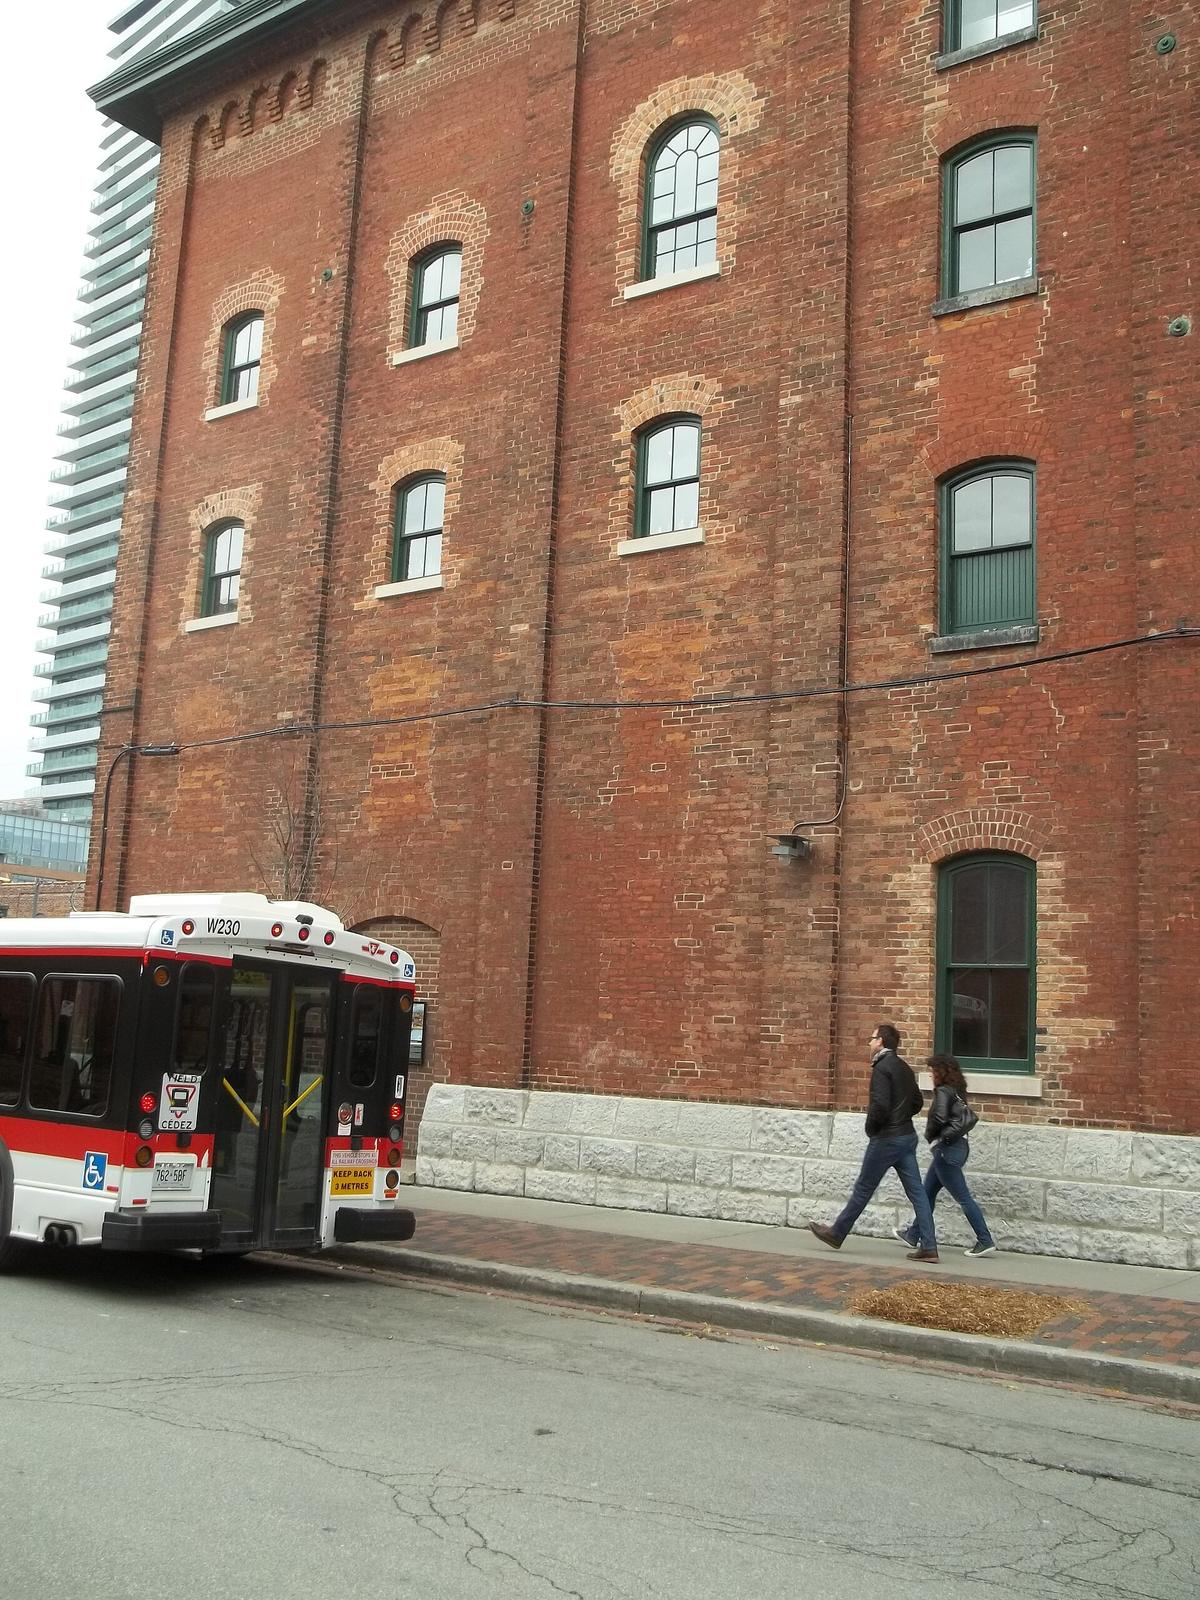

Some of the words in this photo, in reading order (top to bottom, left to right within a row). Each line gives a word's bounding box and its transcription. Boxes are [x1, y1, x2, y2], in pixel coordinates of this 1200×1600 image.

[207, 917, 240, 936] W230
[167, 1073, 198, 1083] YIELD
[161, 1118, 192, 1129] CÉDEZ
[333, 1170, 352, 1178] KEEP
[354, 1170, 372, 1178] BACK
[341, 1182, 369, 1190] METRES
